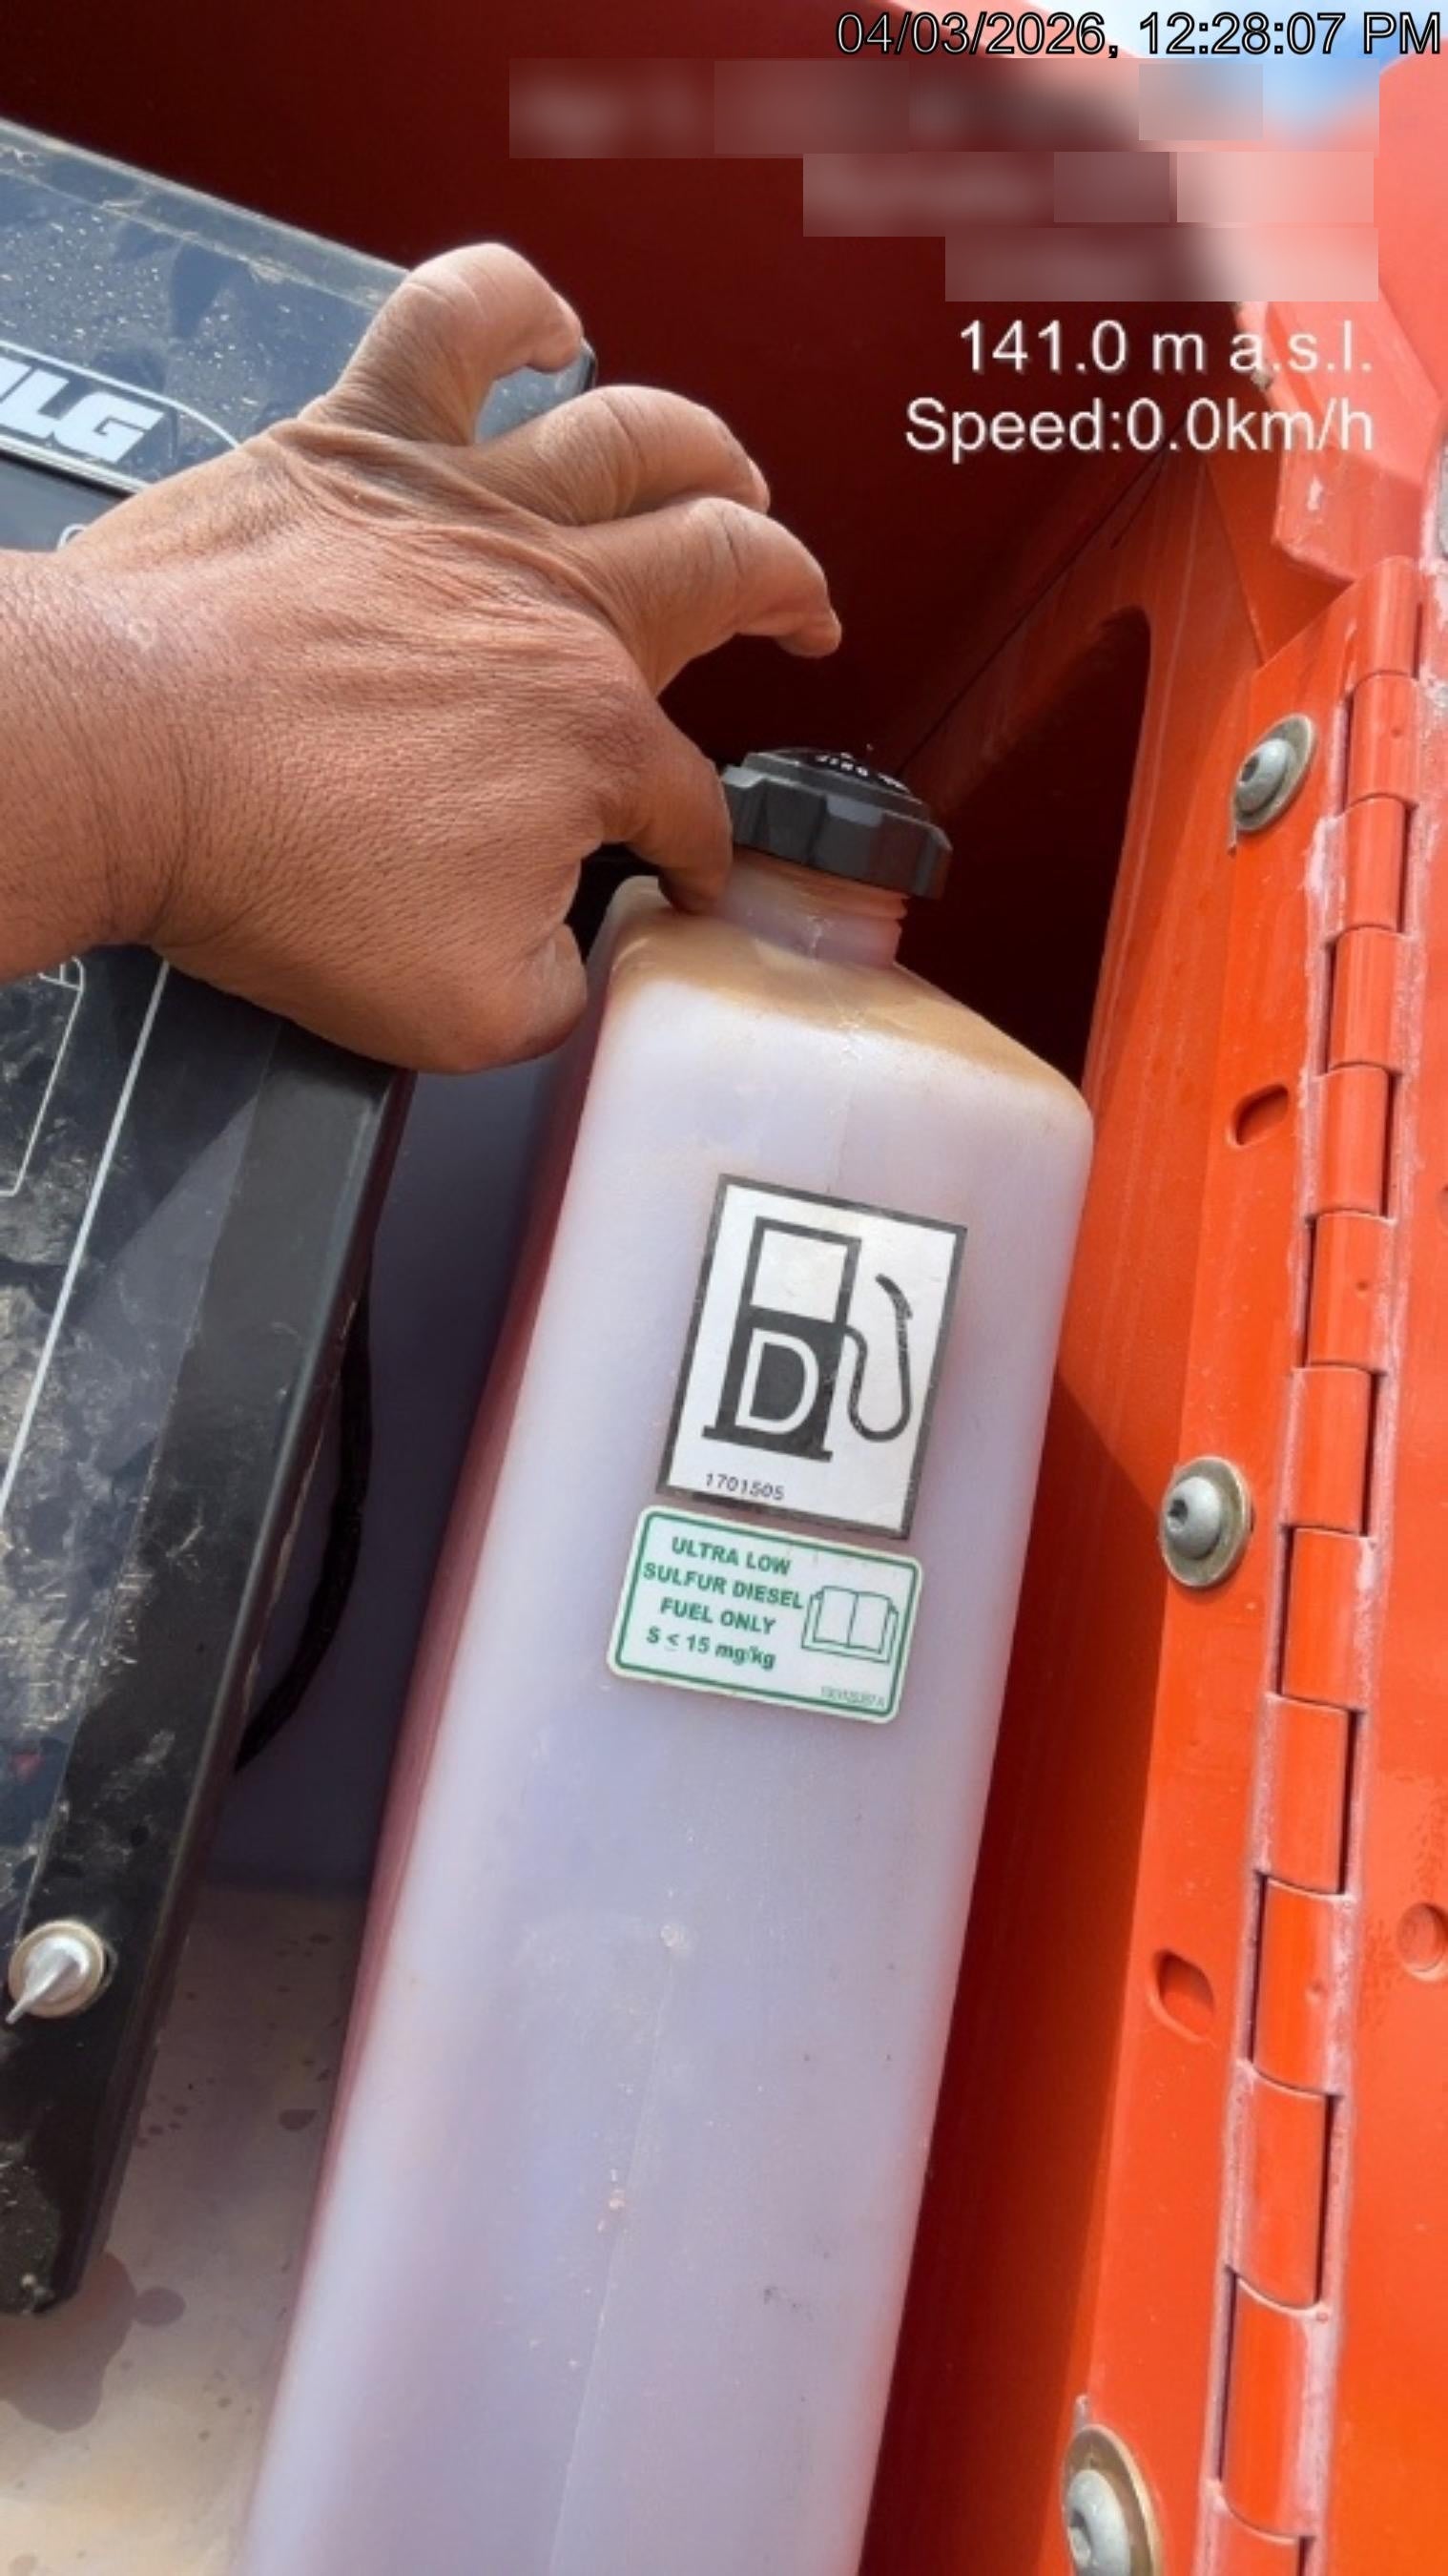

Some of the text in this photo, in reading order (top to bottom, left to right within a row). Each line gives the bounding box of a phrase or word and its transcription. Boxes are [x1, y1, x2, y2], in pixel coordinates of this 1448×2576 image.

[734, 1327, 819, 1435] D
[706, 1472, 785, 1501] 1701505
[672, 1536, 792, 1576] ULTRA LOW
[643, 1562, 804, 1610] SULFUR DIESEL
[660, 1596, 776, 1635] FUEL ONLY
[646, 1625, 661, 1645] S
[686, 1634, 711, 1654] 15
